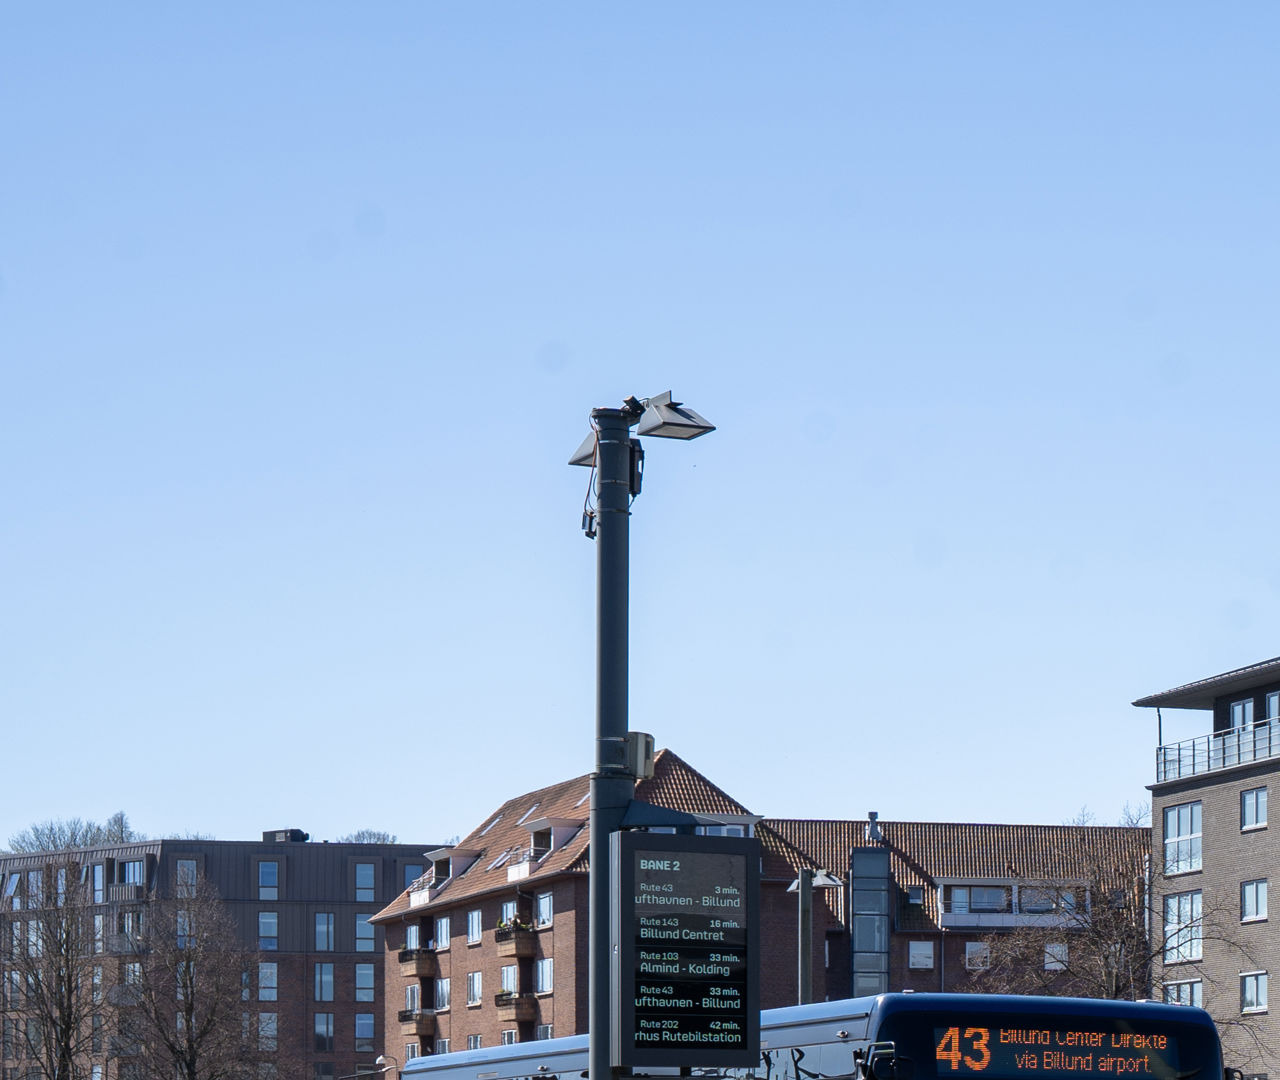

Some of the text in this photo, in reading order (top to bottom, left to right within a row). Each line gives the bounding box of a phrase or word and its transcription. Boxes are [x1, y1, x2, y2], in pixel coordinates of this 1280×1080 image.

[640, 859, 680, 871] BANE 2
[640, 883, 673, 892] Rute 43
[715, 886, 740, 895] 3 min.
[635, 894, 693, 906] ufthavnen
[702, 896, 741, 908] Billund
[640, 917, 679, 927] Rute 143
[710, 920, 740, 929] 16 min.
[640, 928, 724, 941] Billund Centret
[640, 951, 679, 961] Rute 103
[710, 954, 740, 963] 33 min.
[640, 962, 680, 973] Almind
[689, 963, 730, 977] Kolding
[640, 986, 673, 995] Rute 43
[710, 987, 740, 996] 33 min.
[635, 996, 693, 1008] ufthavnen
[702, 997, 741, 1009] Billund
[640, 1020, 679, 1029] Rute 202
[710, 1021, 740, 1030] 42 min.
[635, 1031, 741, 1043] rhus Rutebilstation
[935, 1027, 991, 1071] 43
[1015, 1051, 1152, 1075] via Billund airport
